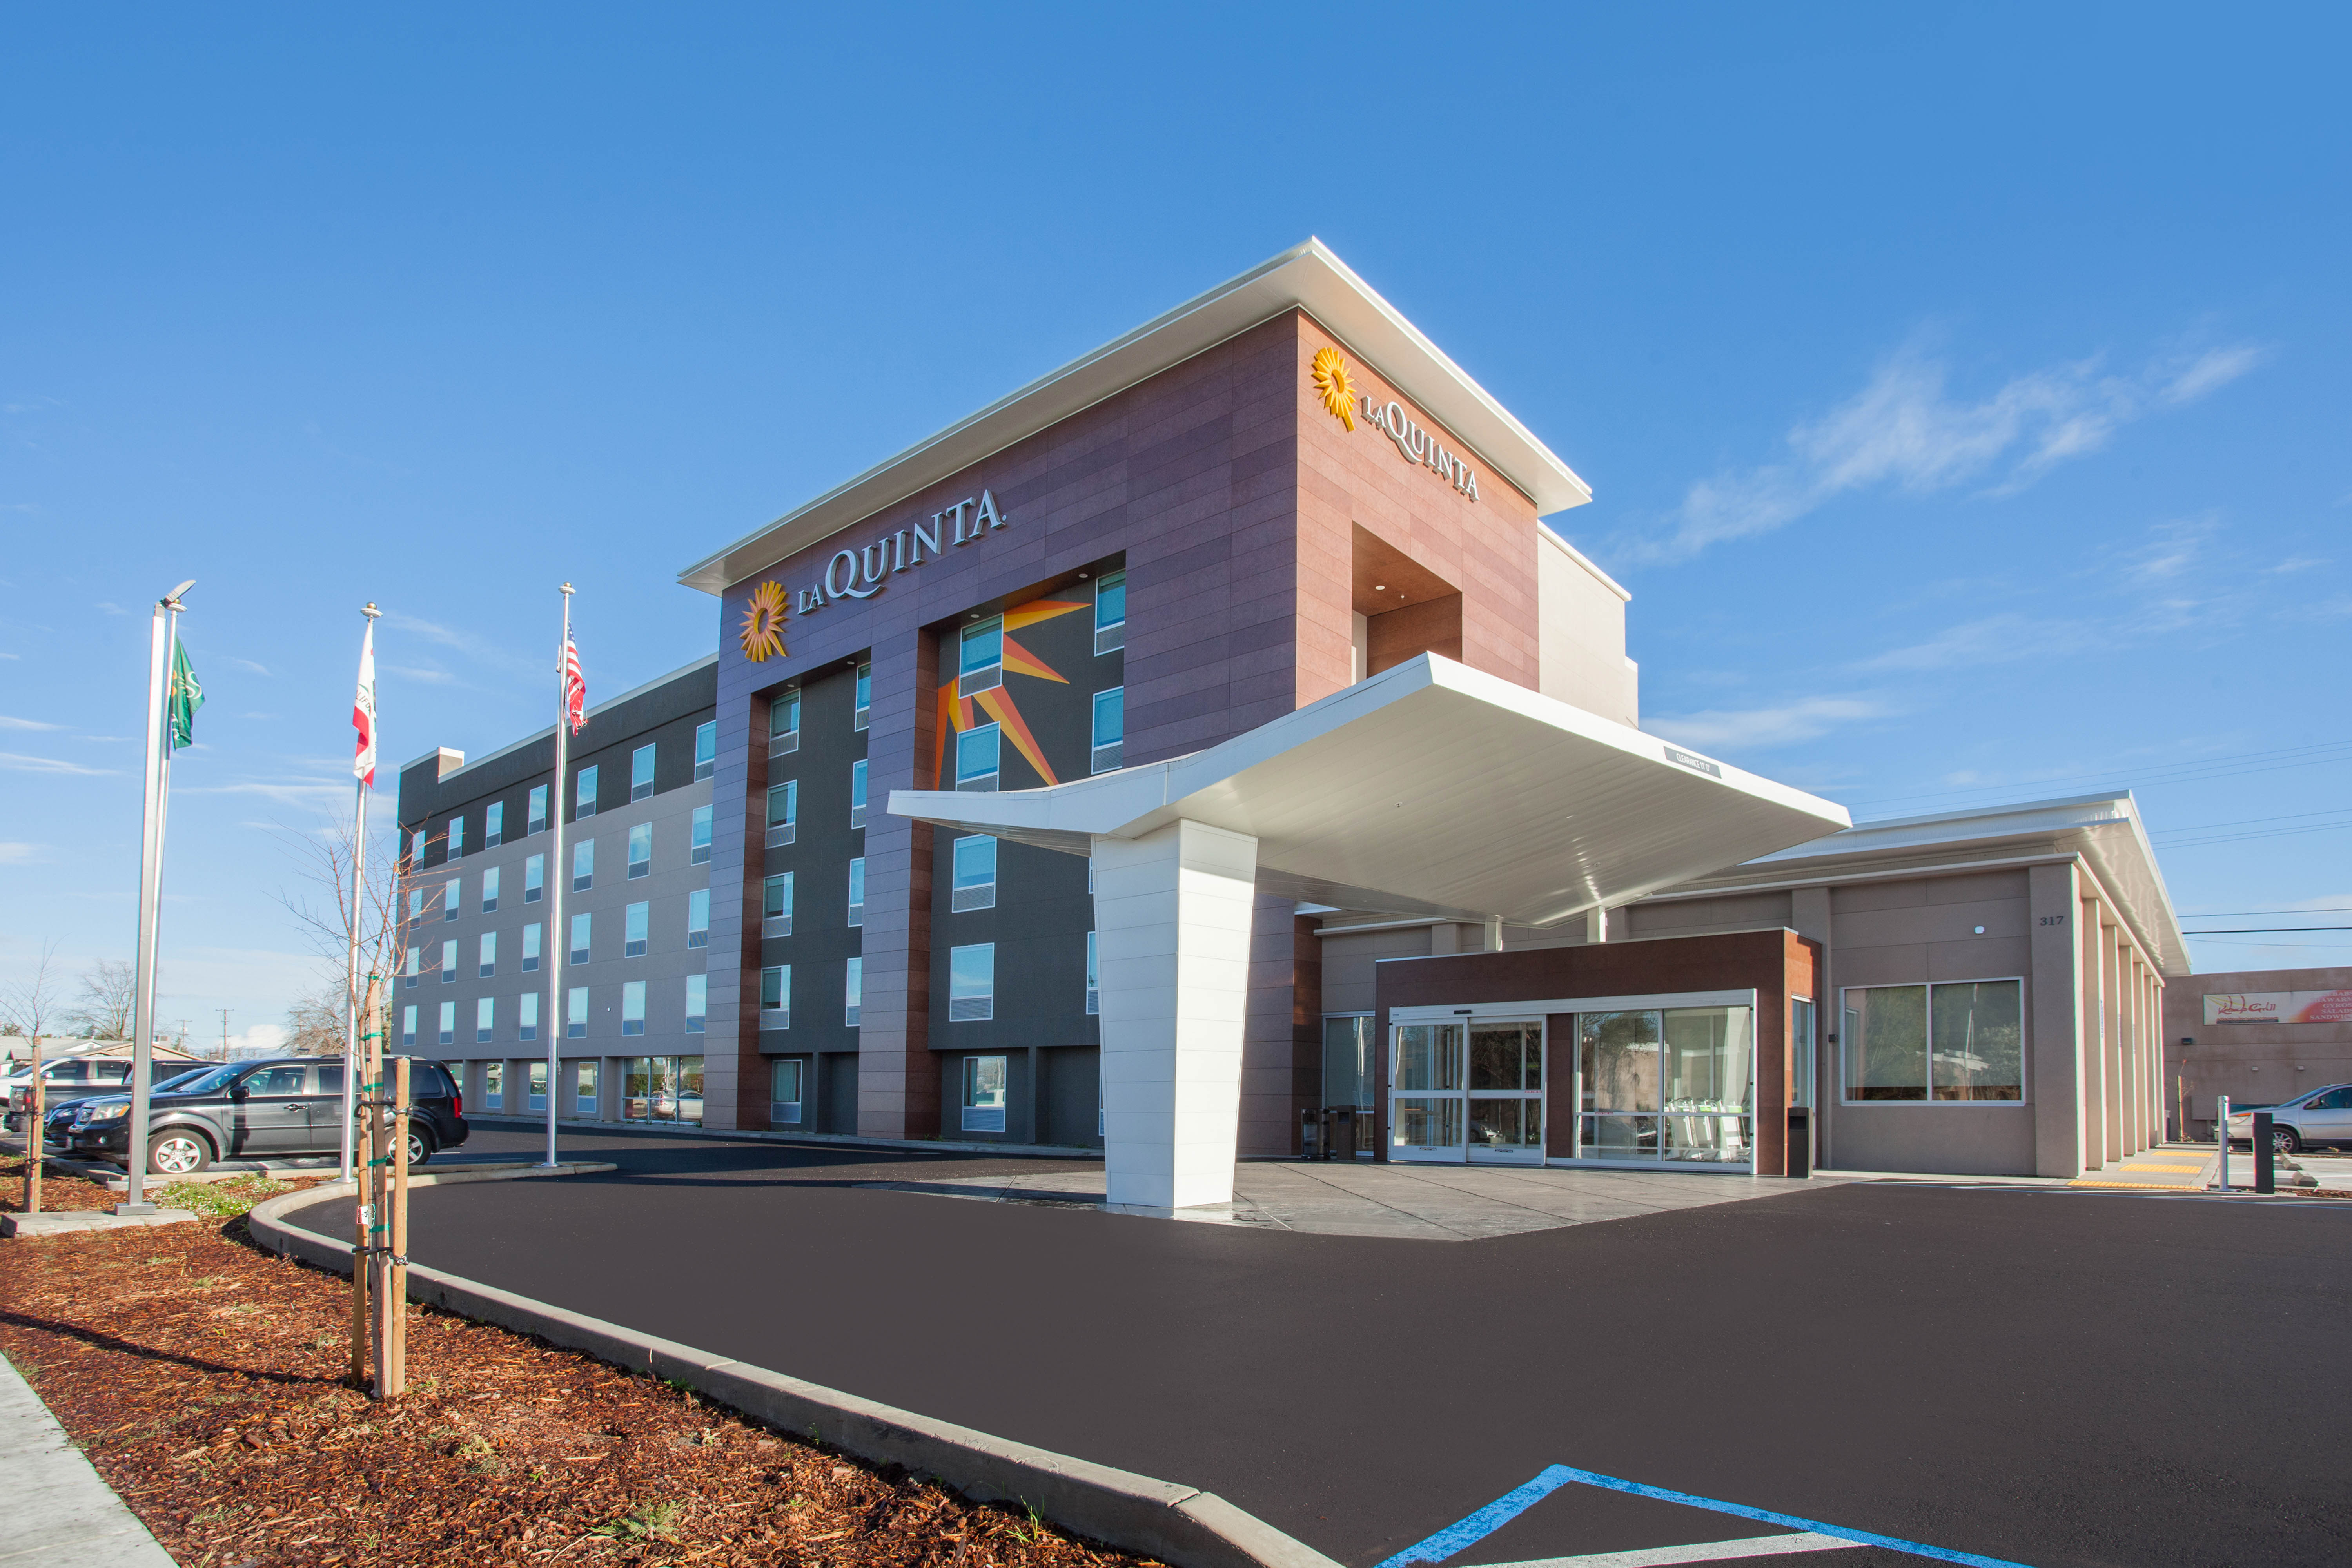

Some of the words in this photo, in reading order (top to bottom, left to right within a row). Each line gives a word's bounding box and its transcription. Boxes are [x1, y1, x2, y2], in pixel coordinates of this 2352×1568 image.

[1361, 395, 1386, 430] LA
[1383, 401, 1480, 503] QUINTA
[797, 584, 828, 615] LA
[1676, 753, 1700, 769] CLEARANCE
[2040, 915, 2064, 926] 317
